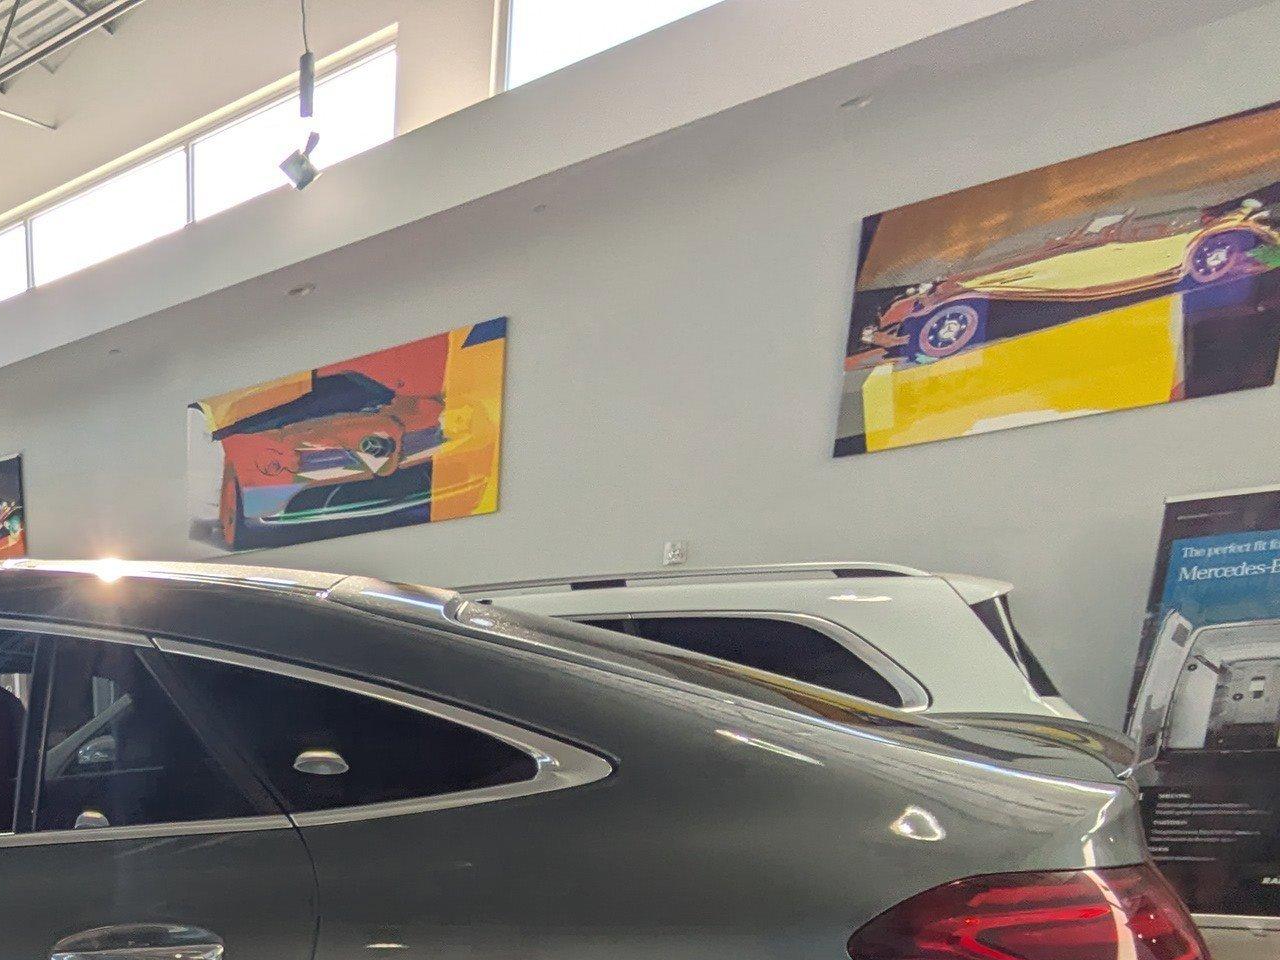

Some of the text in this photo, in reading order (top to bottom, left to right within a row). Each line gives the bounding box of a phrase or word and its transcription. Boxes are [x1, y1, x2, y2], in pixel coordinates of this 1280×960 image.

[1182, 546, 1206, 558] The
[1206, 542, 1252, 558] perfect
[1253, 540, 1267, 551] fit
